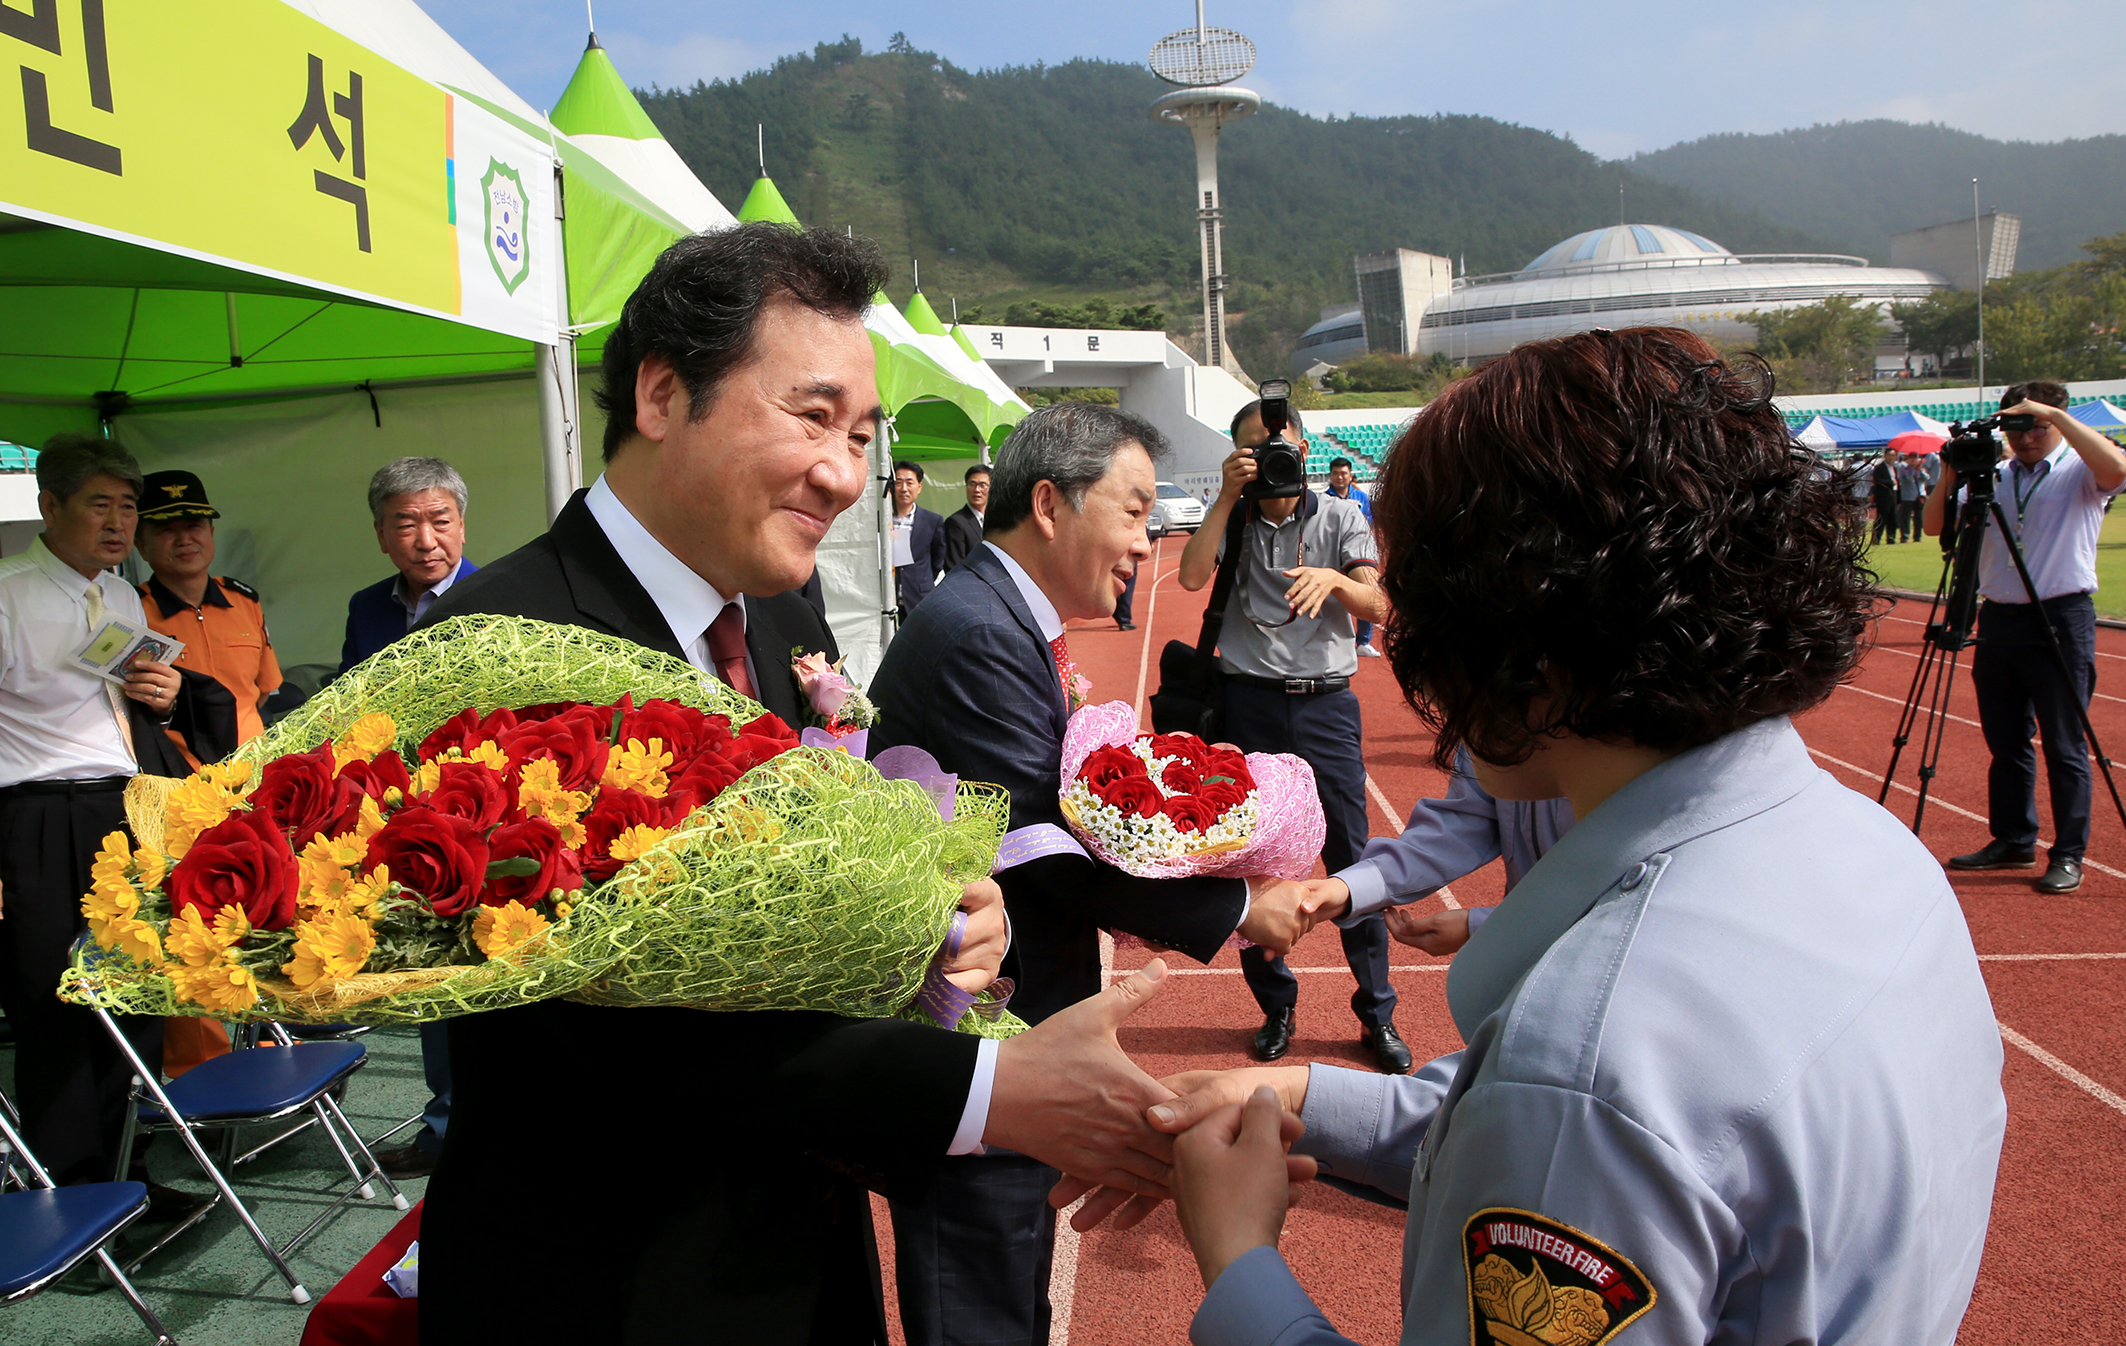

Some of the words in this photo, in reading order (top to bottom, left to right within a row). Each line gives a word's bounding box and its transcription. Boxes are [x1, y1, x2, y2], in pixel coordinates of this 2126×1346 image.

[286, 52, 372, 254] 석
[493, 189, 519, 214] 전남소방
[990, 332, 1003, 350] 직
[1043, 335, 1050, 351] 1
[1087, 336, 1100, 352] 문
[1489, 1224, 1574, 1266] VOLUNTEER
[1571, 1250, 1614, 1284] FIRE
